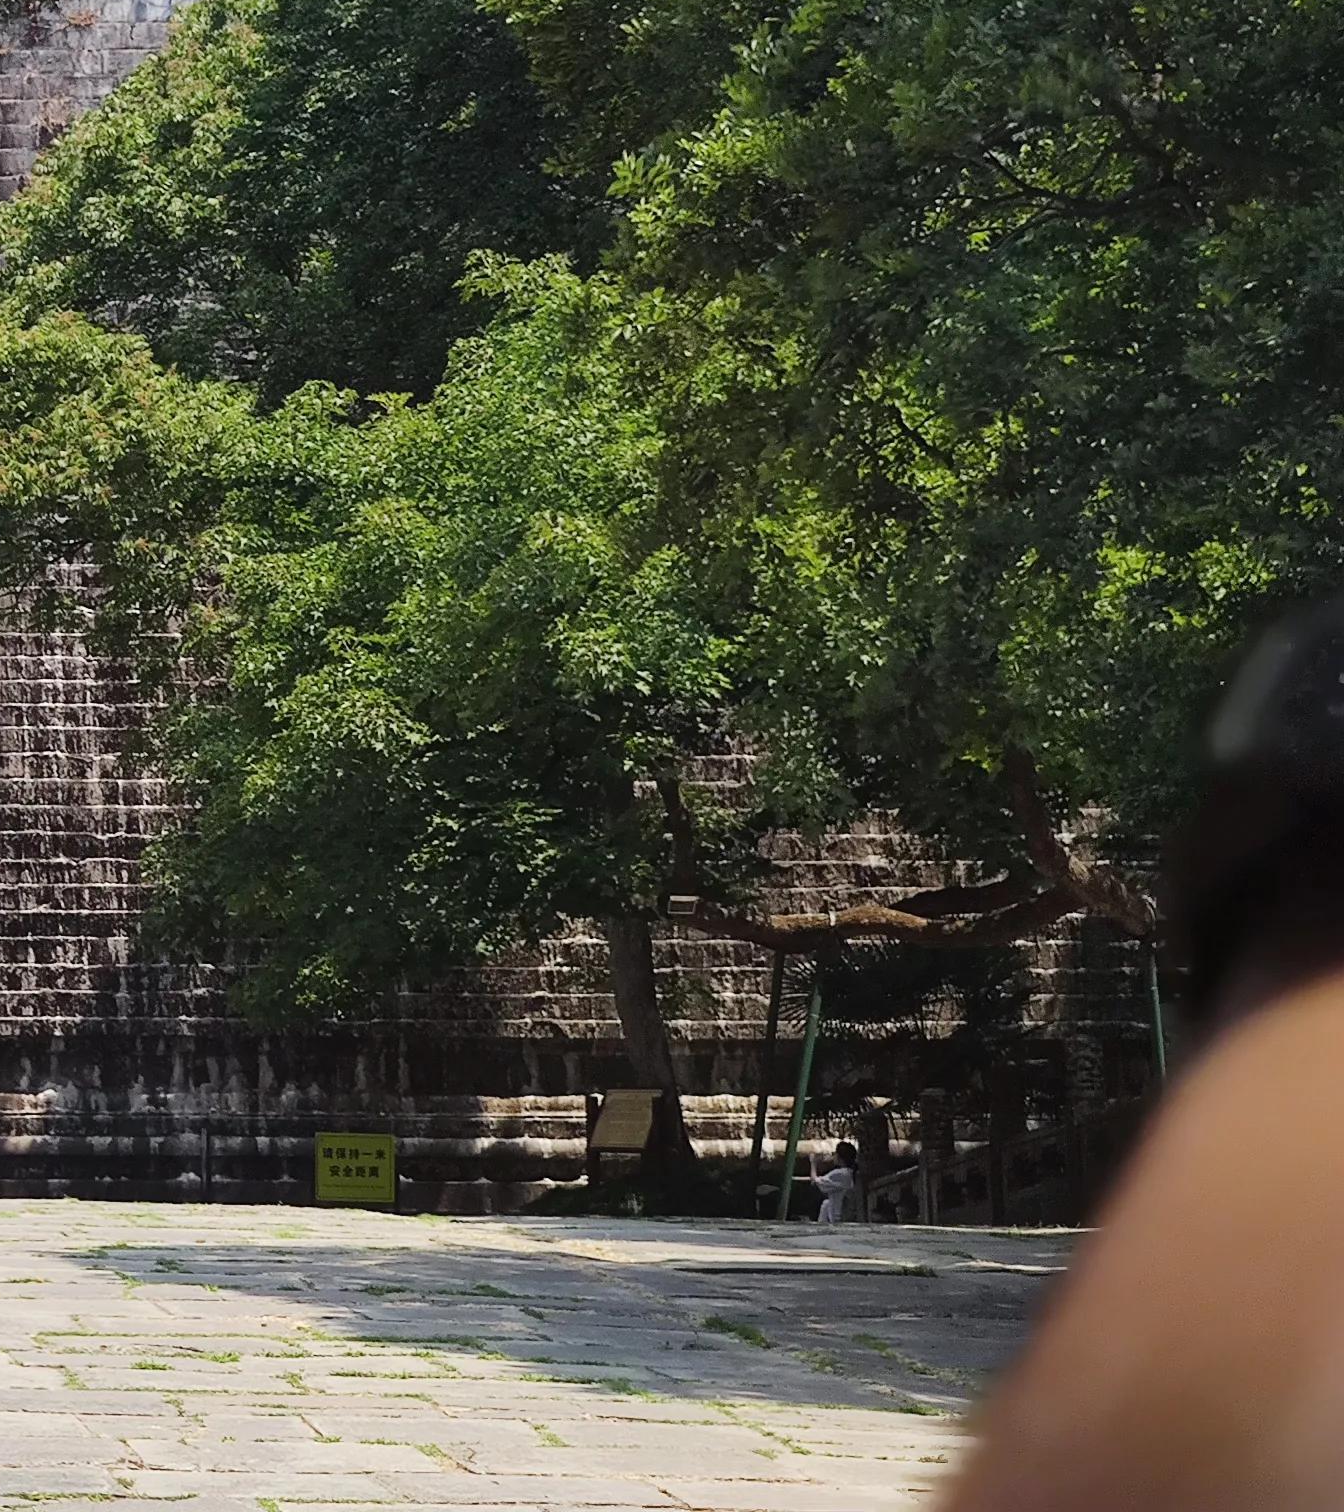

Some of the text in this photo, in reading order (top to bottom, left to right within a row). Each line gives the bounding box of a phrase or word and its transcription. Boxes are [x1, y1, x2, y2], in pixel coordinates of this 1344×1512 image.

[322, 1147, 386, 1160] 请保持一米
[329, 1165, 380, 1178] 安全距离
